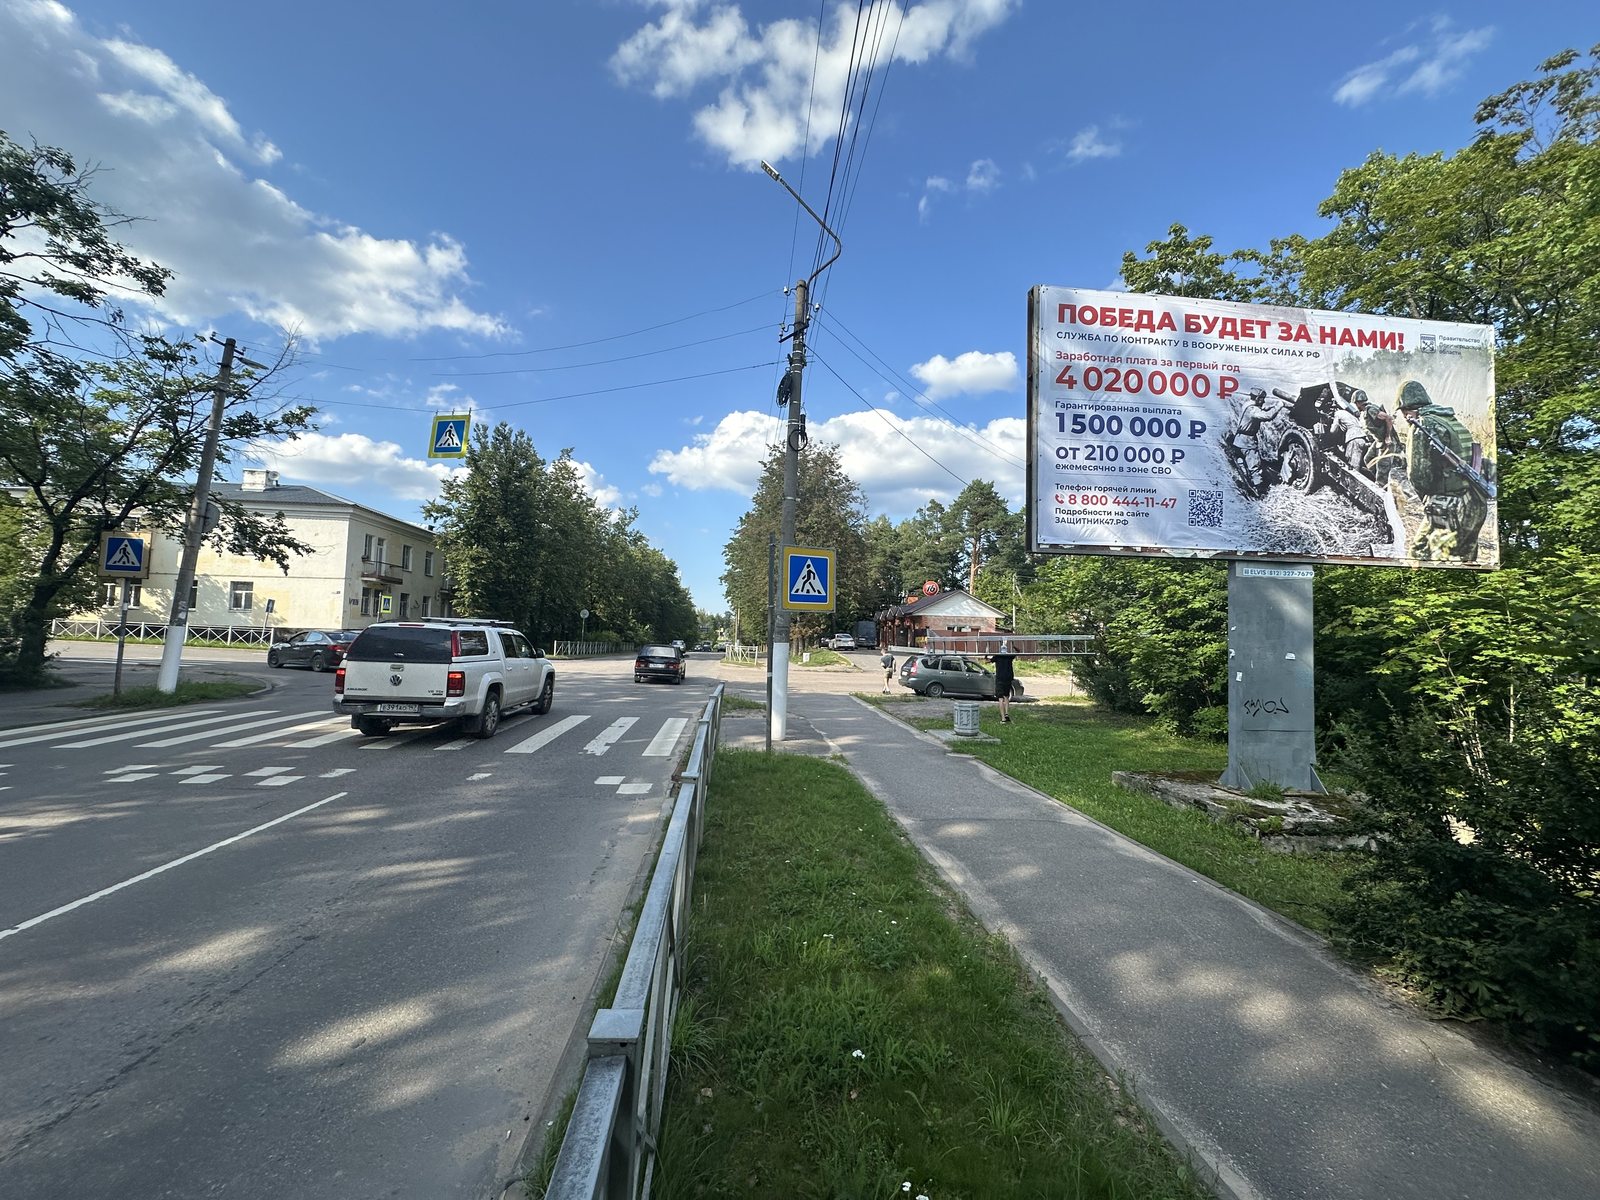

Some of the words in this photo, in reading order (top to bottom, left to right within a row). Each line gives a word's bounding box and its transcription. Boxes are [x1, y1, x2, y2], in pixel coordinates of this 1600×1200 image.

[1057, 303, 1177, 333] ПОБЕДА
[1184, 313, 1271, 340] БУДЕТ
[1278, 322, 1313, 343] ЗА
[1319, 326, 1405, 351] НАМИ!
[1056, 331, 1101, 342] СЛУЖБА
[1104, 334, 1118, 343] ПО
[1121, 336, 1180, 348] КОНТРАКТУ
[1182, 340, 1189, 348] В
[1191, 341, 1269, 354] ВООРУЖЕННЫХ
[1271, 347, 1304, 357] СИЛАХ
[1055, 351, 1123, 364] Заработная
[1126, 356, 1157, 366] плата
[1160, 359, 1173, 367] за
[1175, 360, 1219, 371] первый
[1221, 363, 1241, 373] год
[1055, 401, 1140, 413] Гарантированная
[1142, 406, 1182, 415] выплата
[1129, 416, 1182, 439] 000
[1055, 446, 1080, 460] от
[1084, 444, 1119, 462] 210
[1123, 446, 1165, 464] 000
[1055, 463, 1116, 473] ежемесячно
[1126, 466, 1149, 474] зоне
[1151, 466, 1172, 475] СВО
[1055, 483, 1092, 493] Телефон
[1094, 485, 1128, 494] горячей
[1068, 494, 1077, 505] 8
[1081, 495, 1108, 506] 800
[1112, 496, 1177, 509] 444-11-47
[1055, 507, 1112, 517] Подробности
[1126, 509, 1150, 518] сайте
[1055, 516, 1129, 526] ЗАЩИТНИК47.РФ
